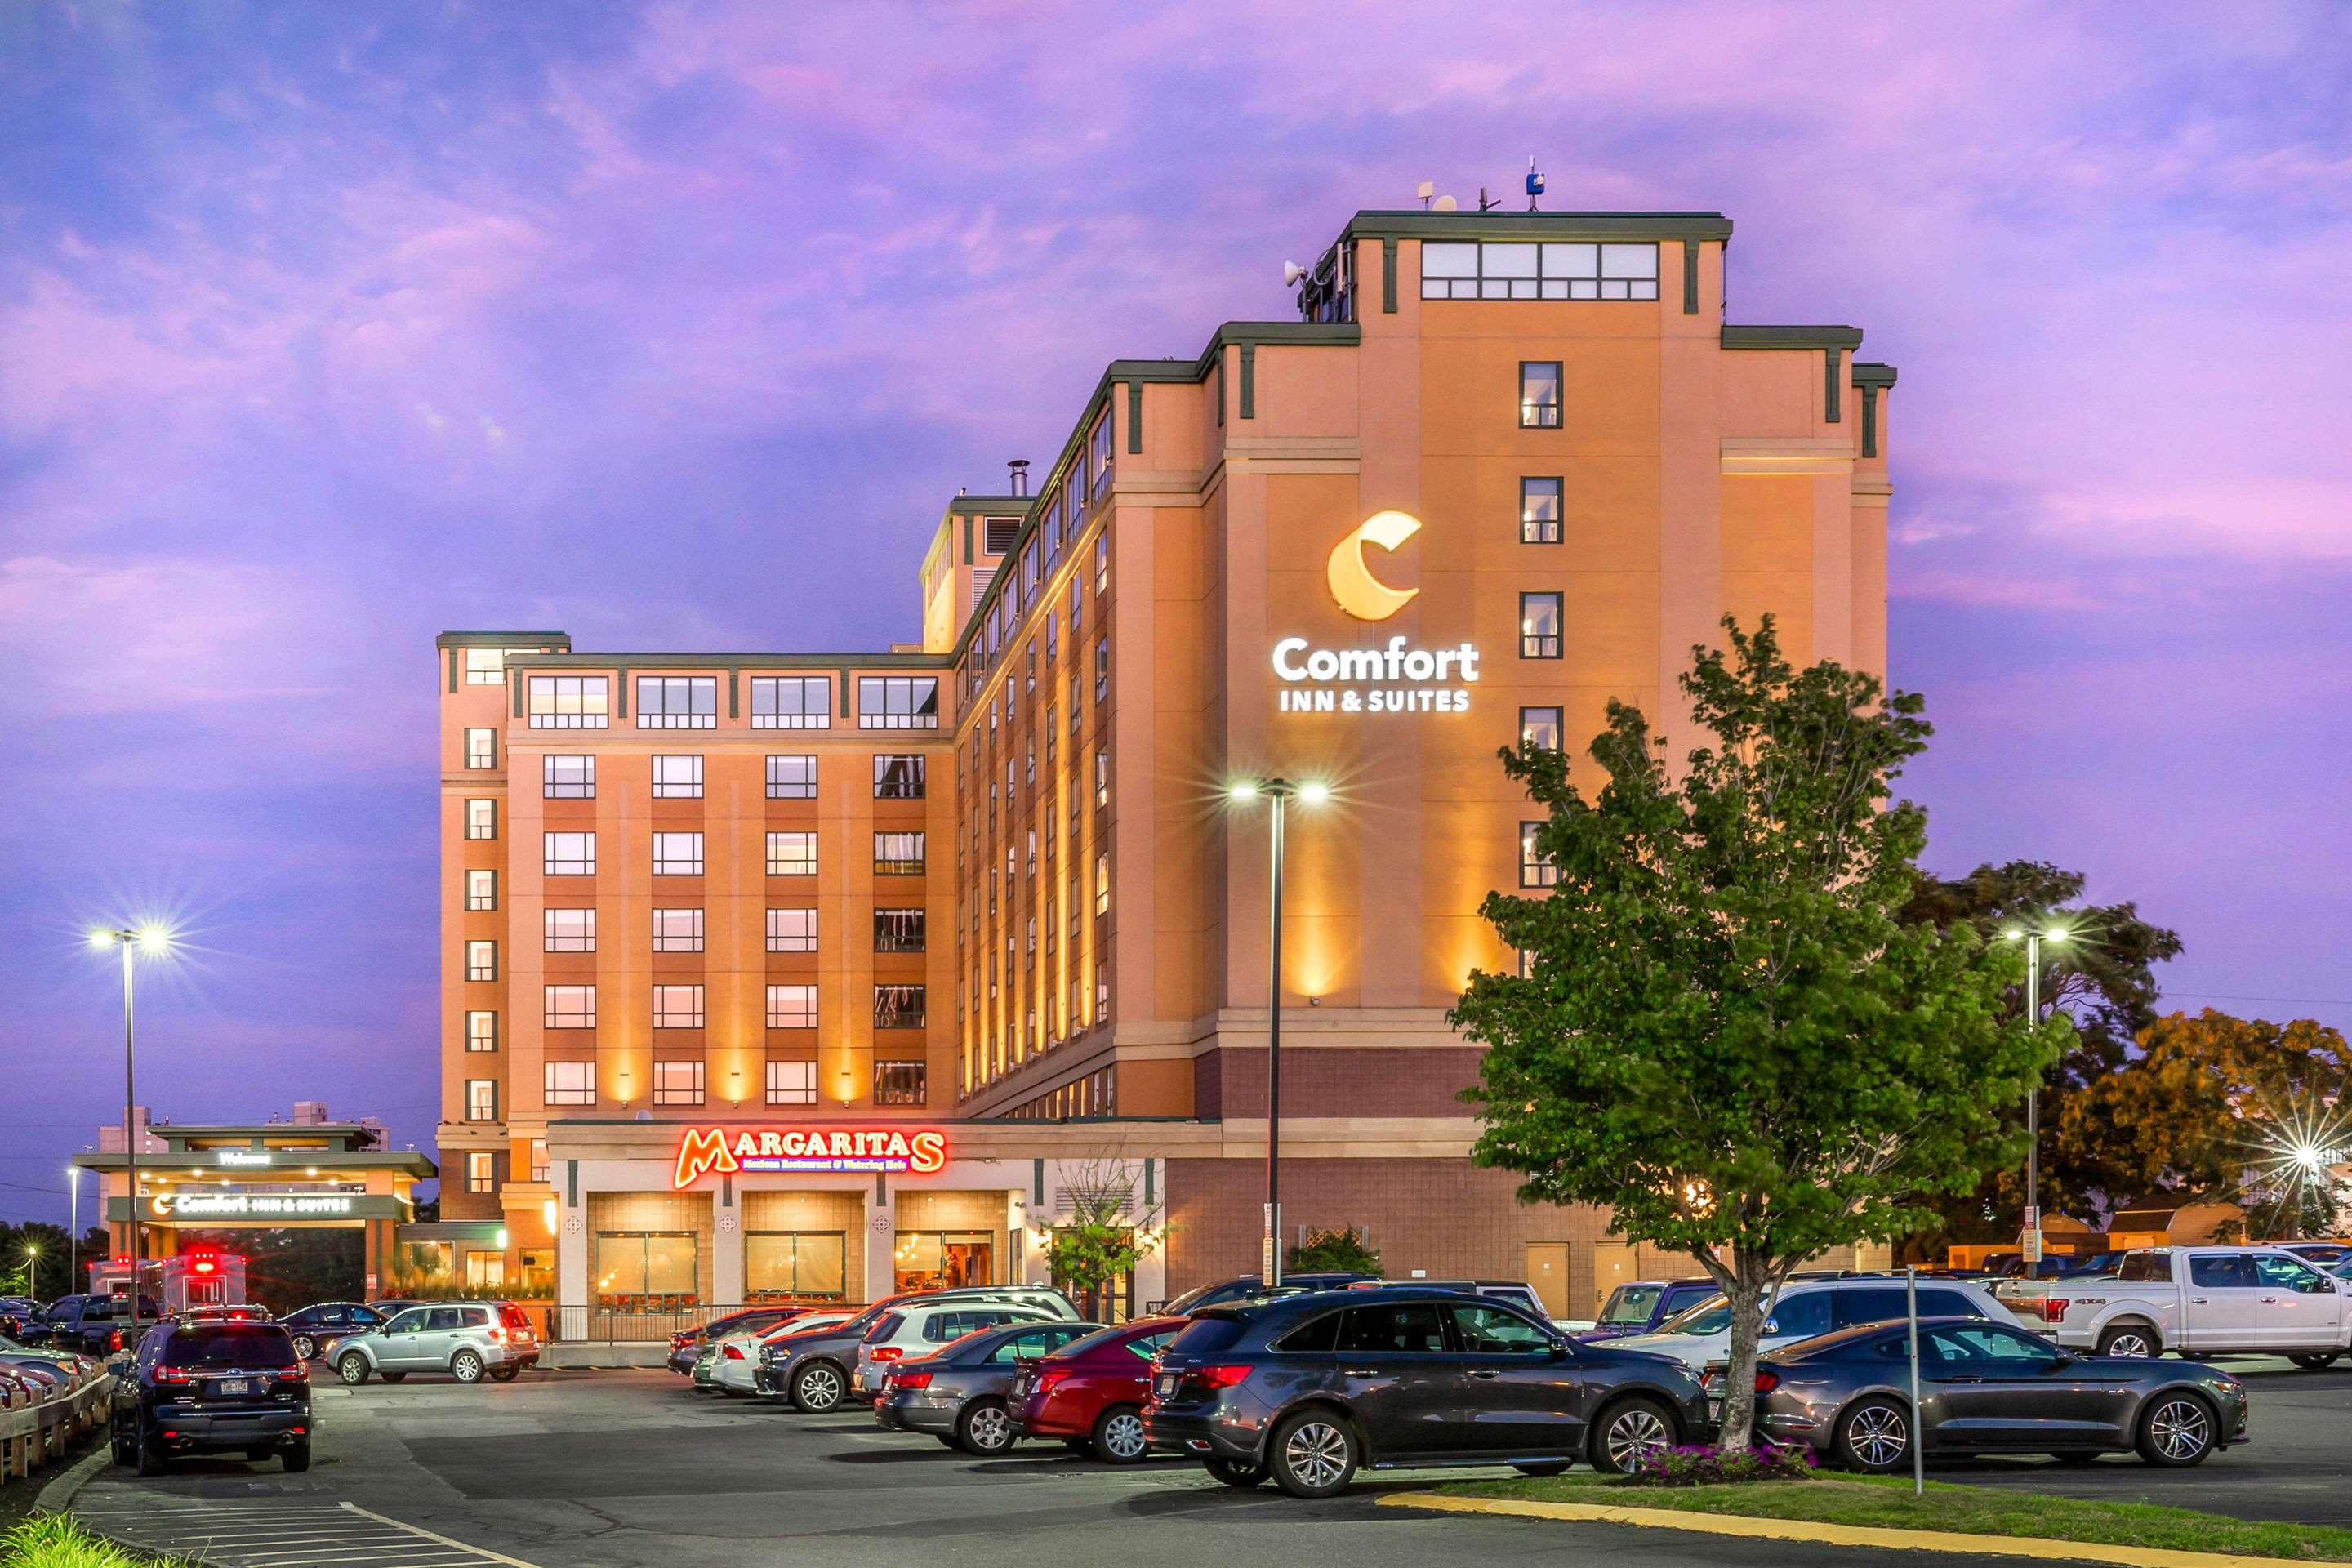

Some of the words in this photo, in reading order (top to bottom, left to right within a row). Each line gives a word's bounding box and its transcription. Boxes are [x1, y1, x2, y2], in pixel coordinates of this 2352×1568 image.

[1272, 636, 1480, 681] Comfort
[1280, 690, 1334, 711] INN
[1341, 690, 1362, 711] &
[1367, 690, 1469, 711] SUITES
[674, 1128, 944, 1189] MARGARITAS
[176, 1195, 248, 1213] Comfort
